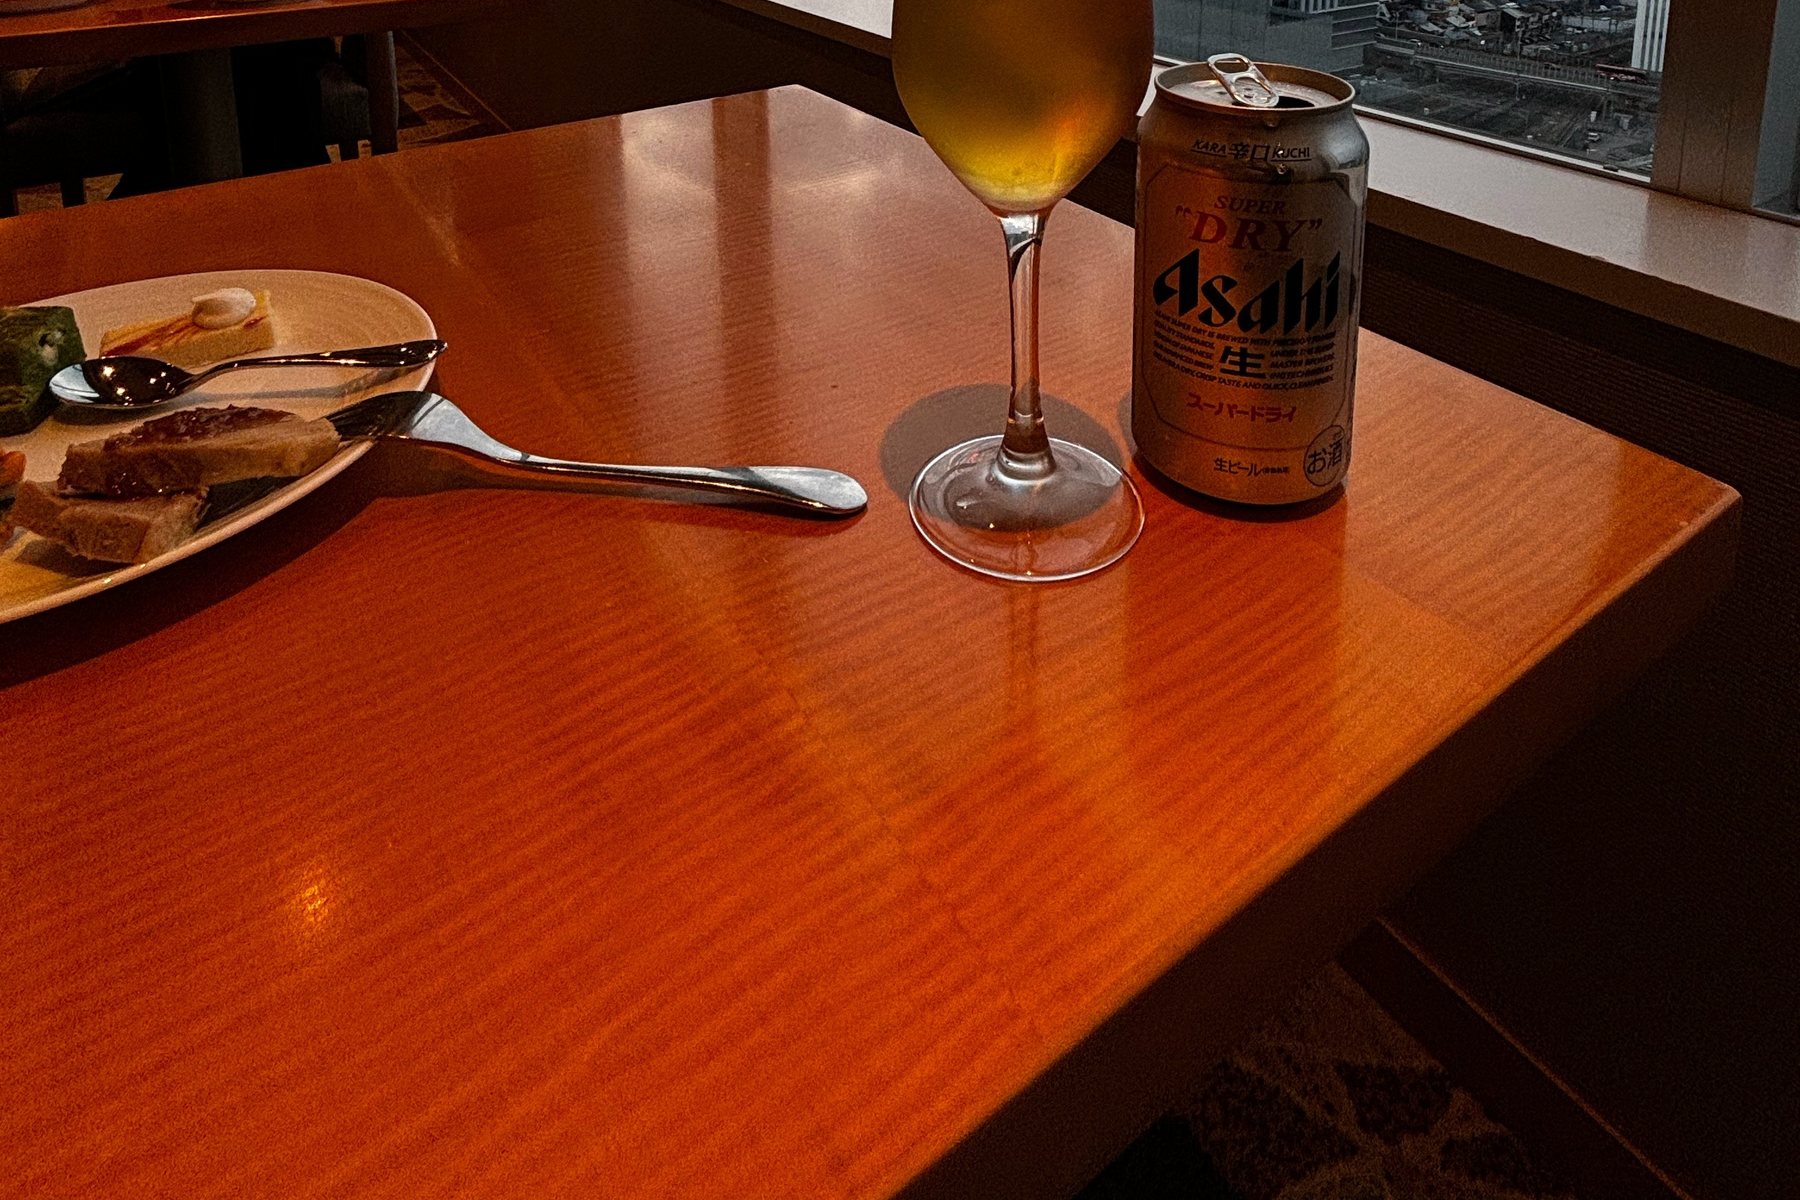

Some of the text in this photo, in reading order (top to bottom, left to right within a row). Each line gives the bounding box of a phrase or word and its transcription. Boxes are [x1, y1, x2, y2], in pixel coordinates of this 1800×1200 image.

[1192, 138, 1310, 162] KARA 辛口 KUCHI
[1215, 195, 1286, 215] SUPER
[1152, 247, 1341, 336] Asahi
[1219, 345, 1267, 380] 生
[1217, 376, 1241, 388] TASTE
[1241, 381, 1261, 390] AND
[1186, 391, 1297, 423] スーパードライ
[1307, 437, 1344, 475] お酒
